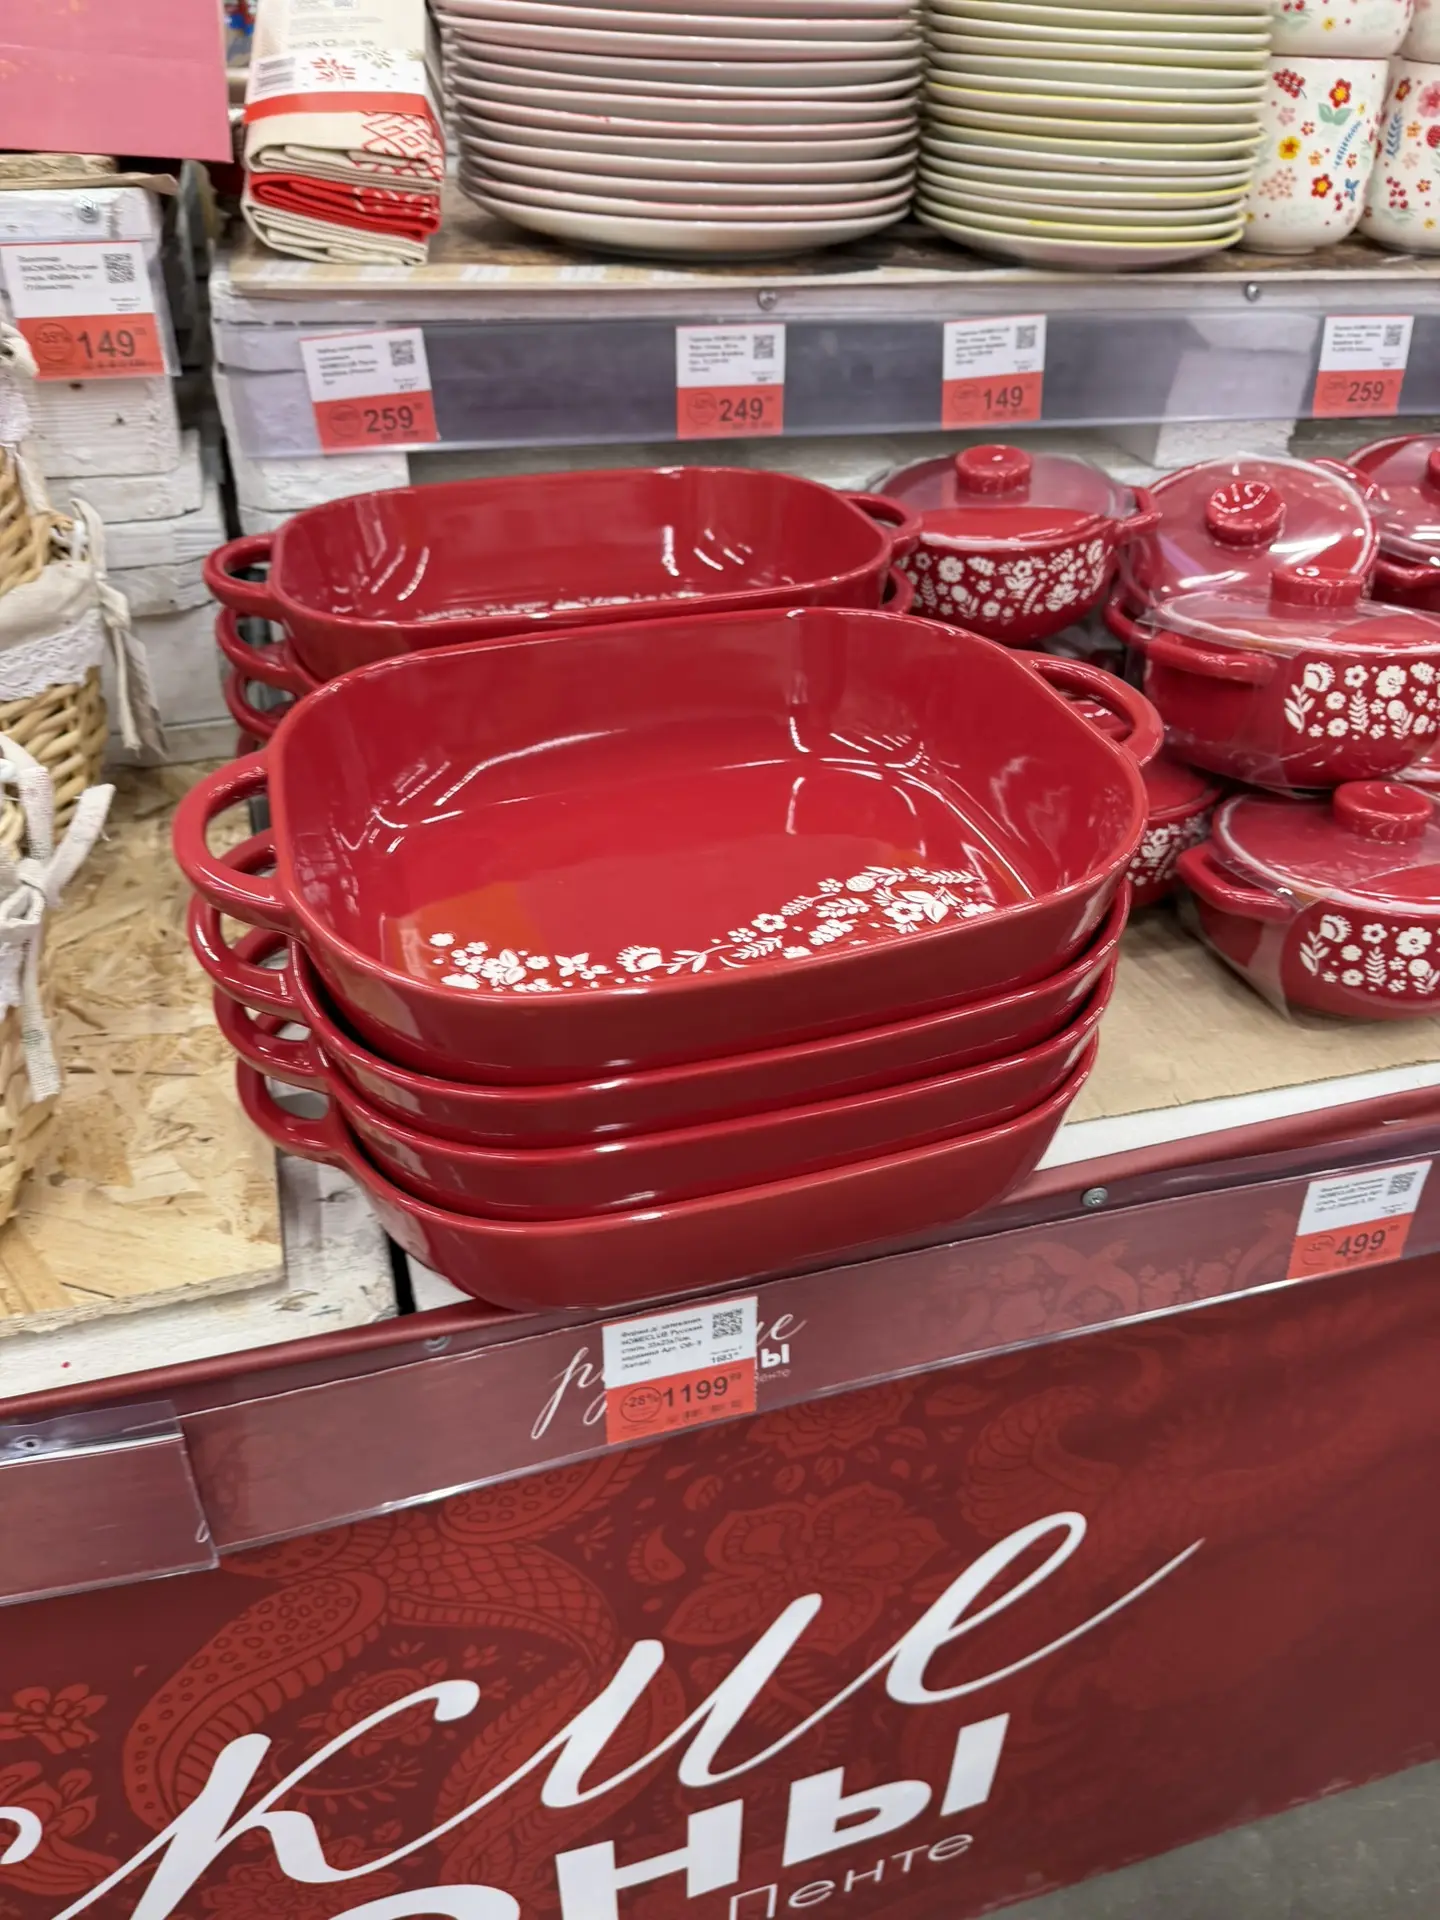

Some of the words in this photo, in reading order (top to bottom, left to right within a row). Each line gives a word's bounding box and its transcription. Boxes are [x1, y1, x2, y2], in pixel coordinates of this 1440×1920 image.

[77, 329, 136, 359] 149
[983, 385, 1024, 410] 149
[1347, 380, 1385, 403] 259
[363, 405, 414, 433] 259
[718, 396, 764, 422] 249
[1335, 1229, 1386, 1257] 499
[663, 1376, 729, 1407] 1199
[0, 1511, 1205, 1920] кие
